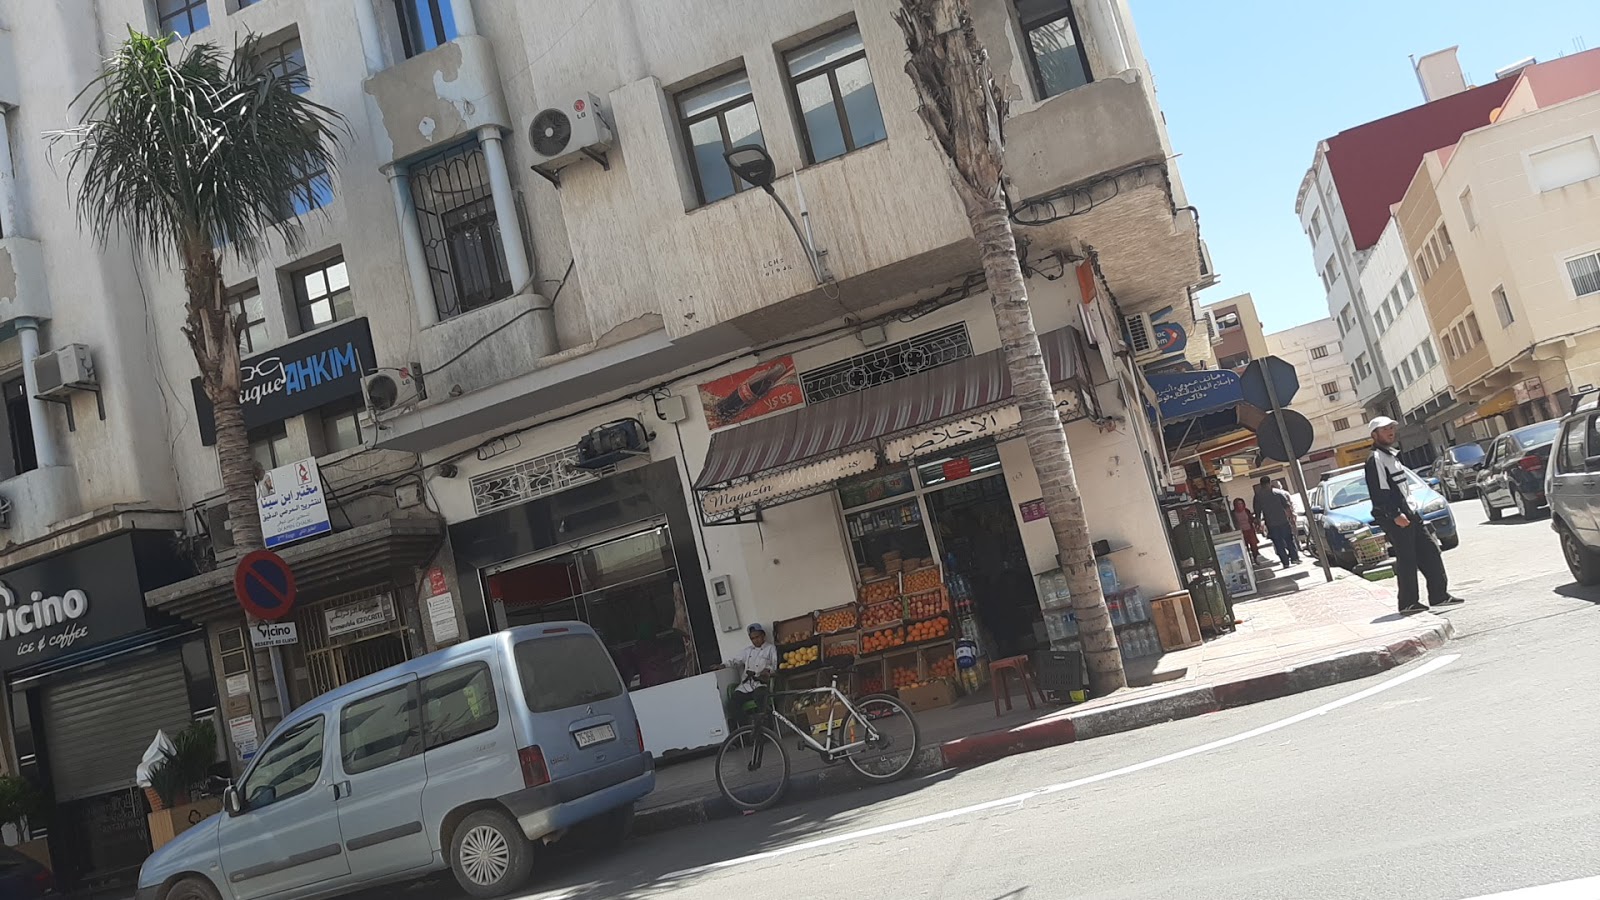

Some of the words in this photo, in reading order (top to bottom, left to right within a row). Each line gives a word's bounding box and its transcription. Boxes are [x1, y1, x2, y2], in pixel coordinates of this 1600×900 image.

[576, 112, 586, 120] LG
[285, 342, 357, 396] AHKIM
[280, 490, 293, 506] ابن
[295, 484, 318, 500] مختبر
[260, 497, 279, 509] سينا
[17, 642, 35, 655] ice
[38, 635, 46, 652] &
[49, 623, 88, 648] coffee
